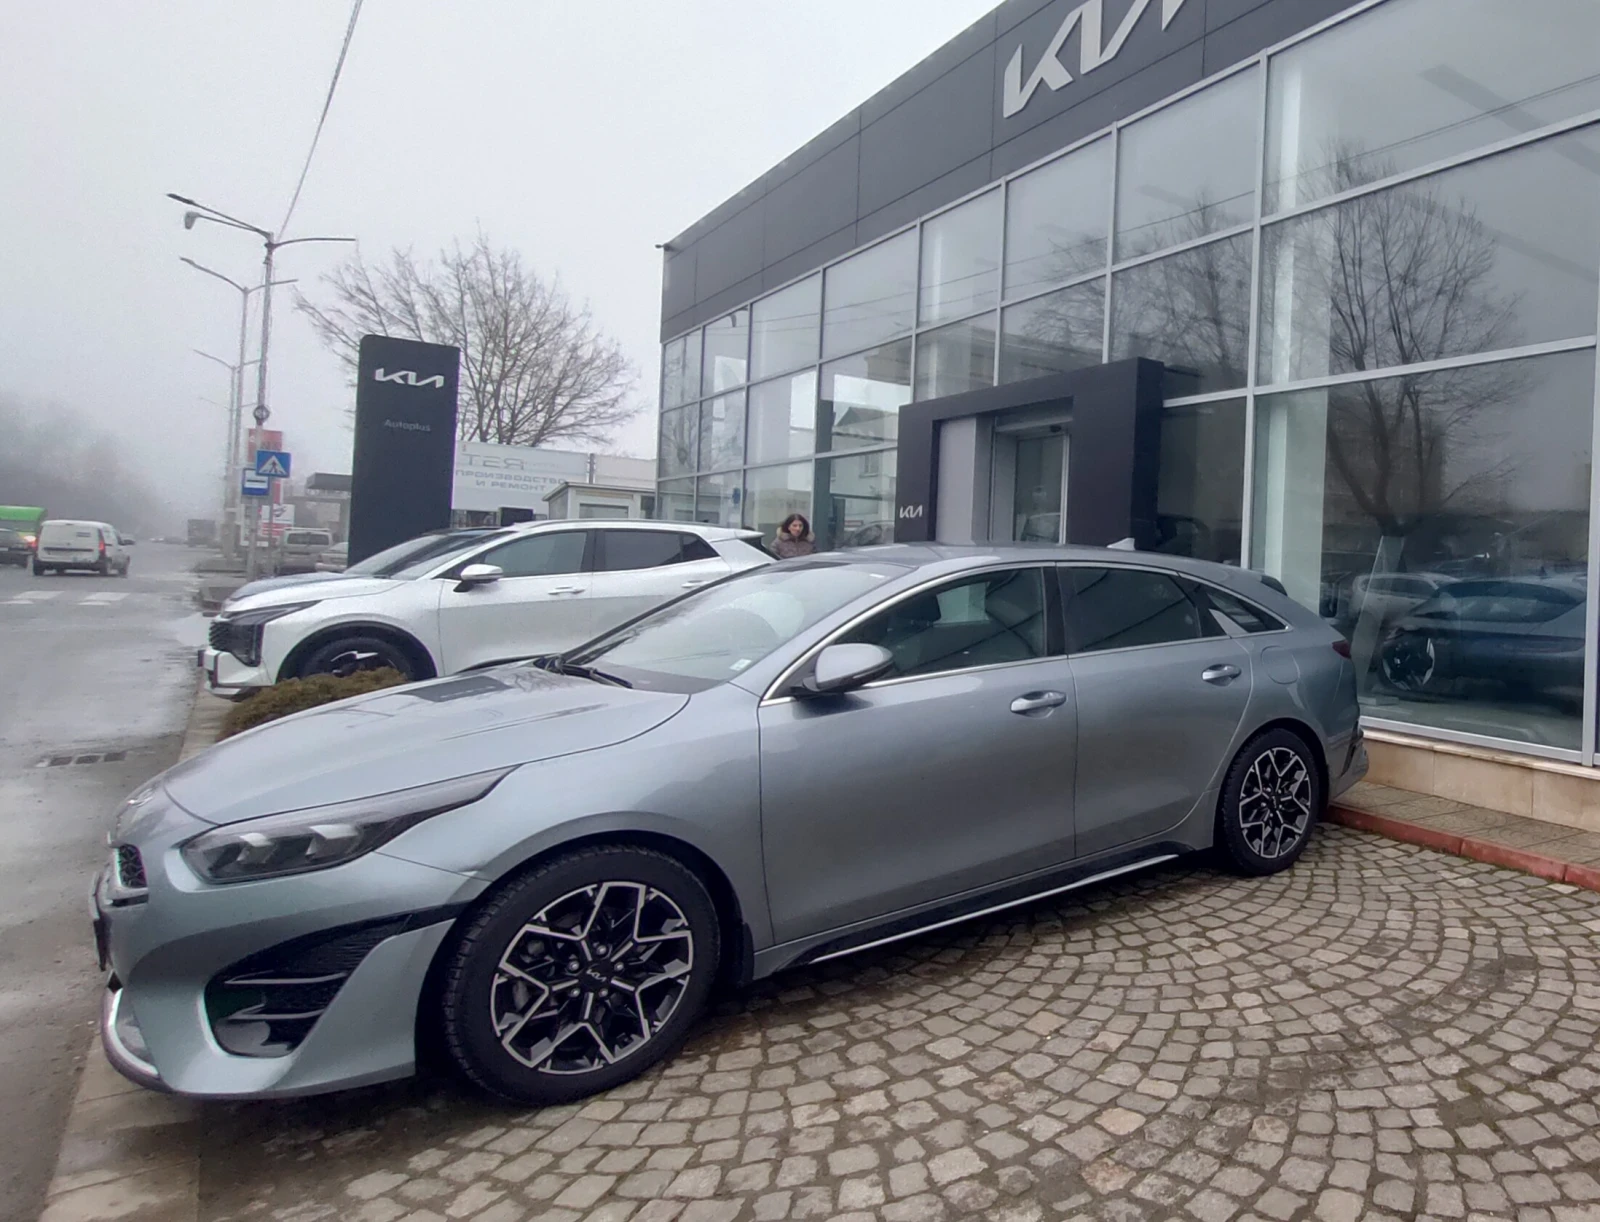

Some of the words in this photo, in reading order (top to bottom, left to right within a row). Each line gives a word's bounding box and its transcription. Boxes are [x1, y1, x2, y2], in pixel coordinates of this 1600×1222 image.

[375, 368, 444, 388] KIA
[384, 419, 431, 432] Autoplus
[491, 480, 547, 491] РЕМОНТ
[899, 504, 923, 518] KIA
